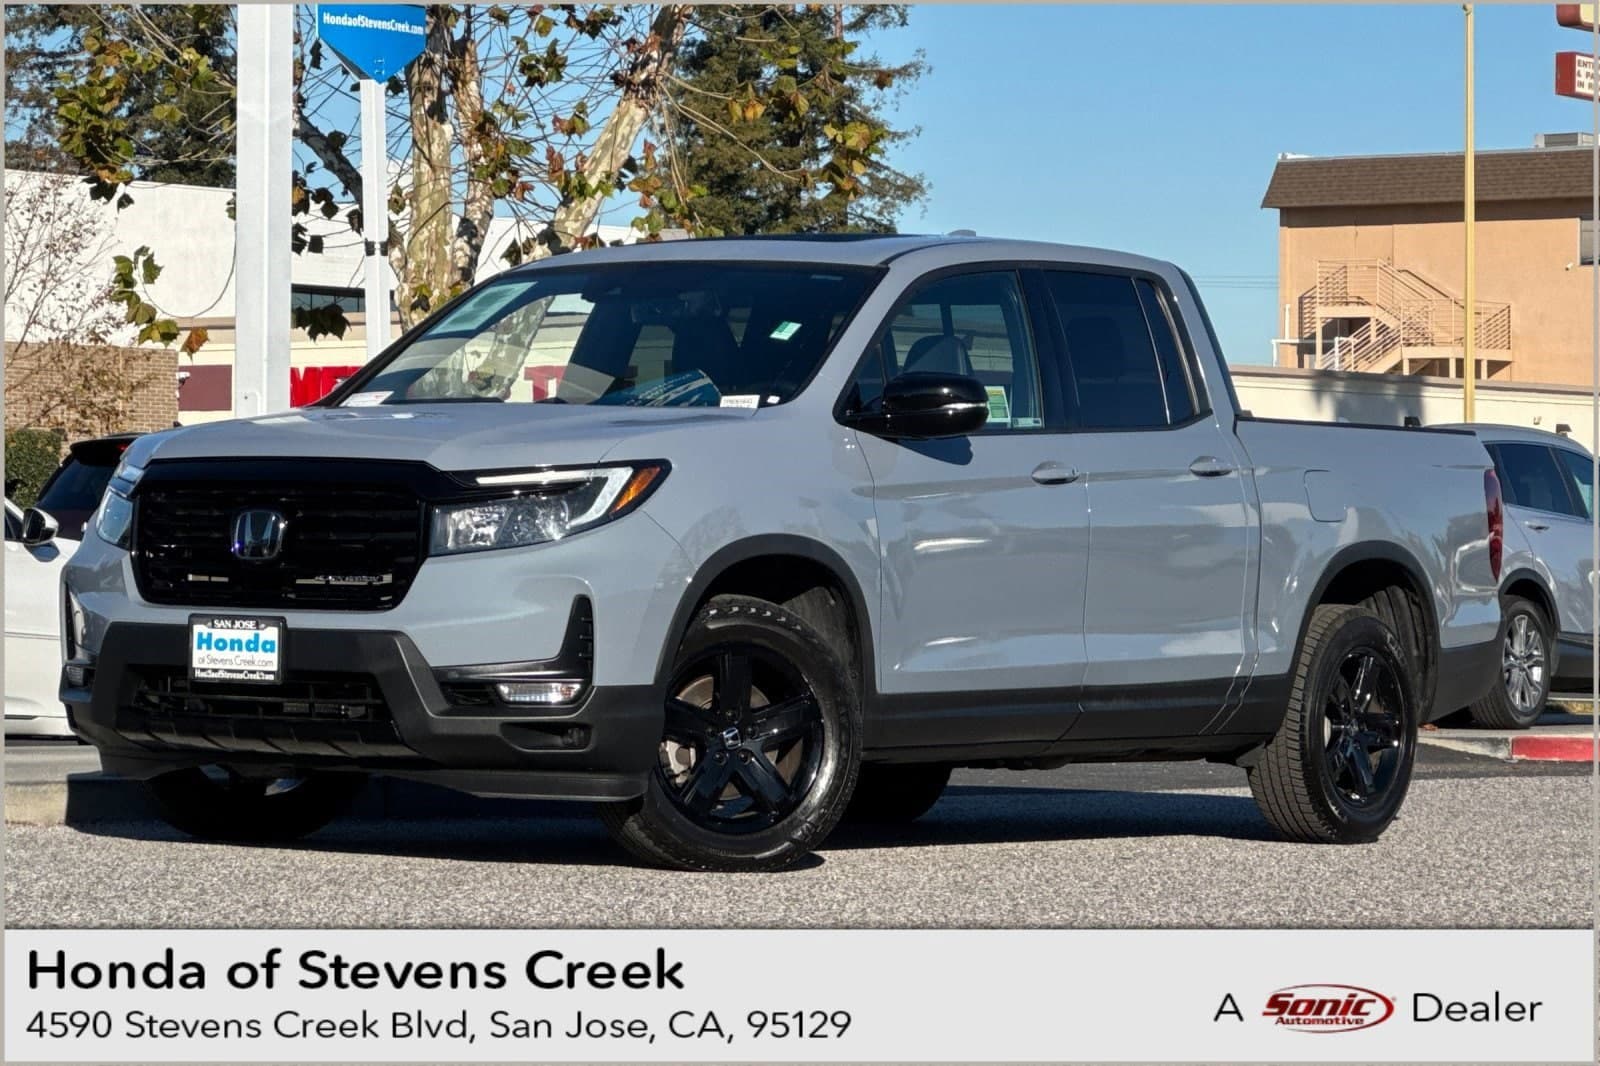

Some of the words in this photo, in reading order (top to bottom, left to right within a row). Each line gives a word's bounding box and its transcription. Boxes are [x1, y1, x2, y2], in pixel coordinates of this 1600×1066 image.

[213, 619, 232, 628] SAN
[234, 620, 257, 629] JOSE
[197, 631, 276, 653] Honda
[198, 655, 205, 664] of
[207, 654, 233, 666] Stevens
